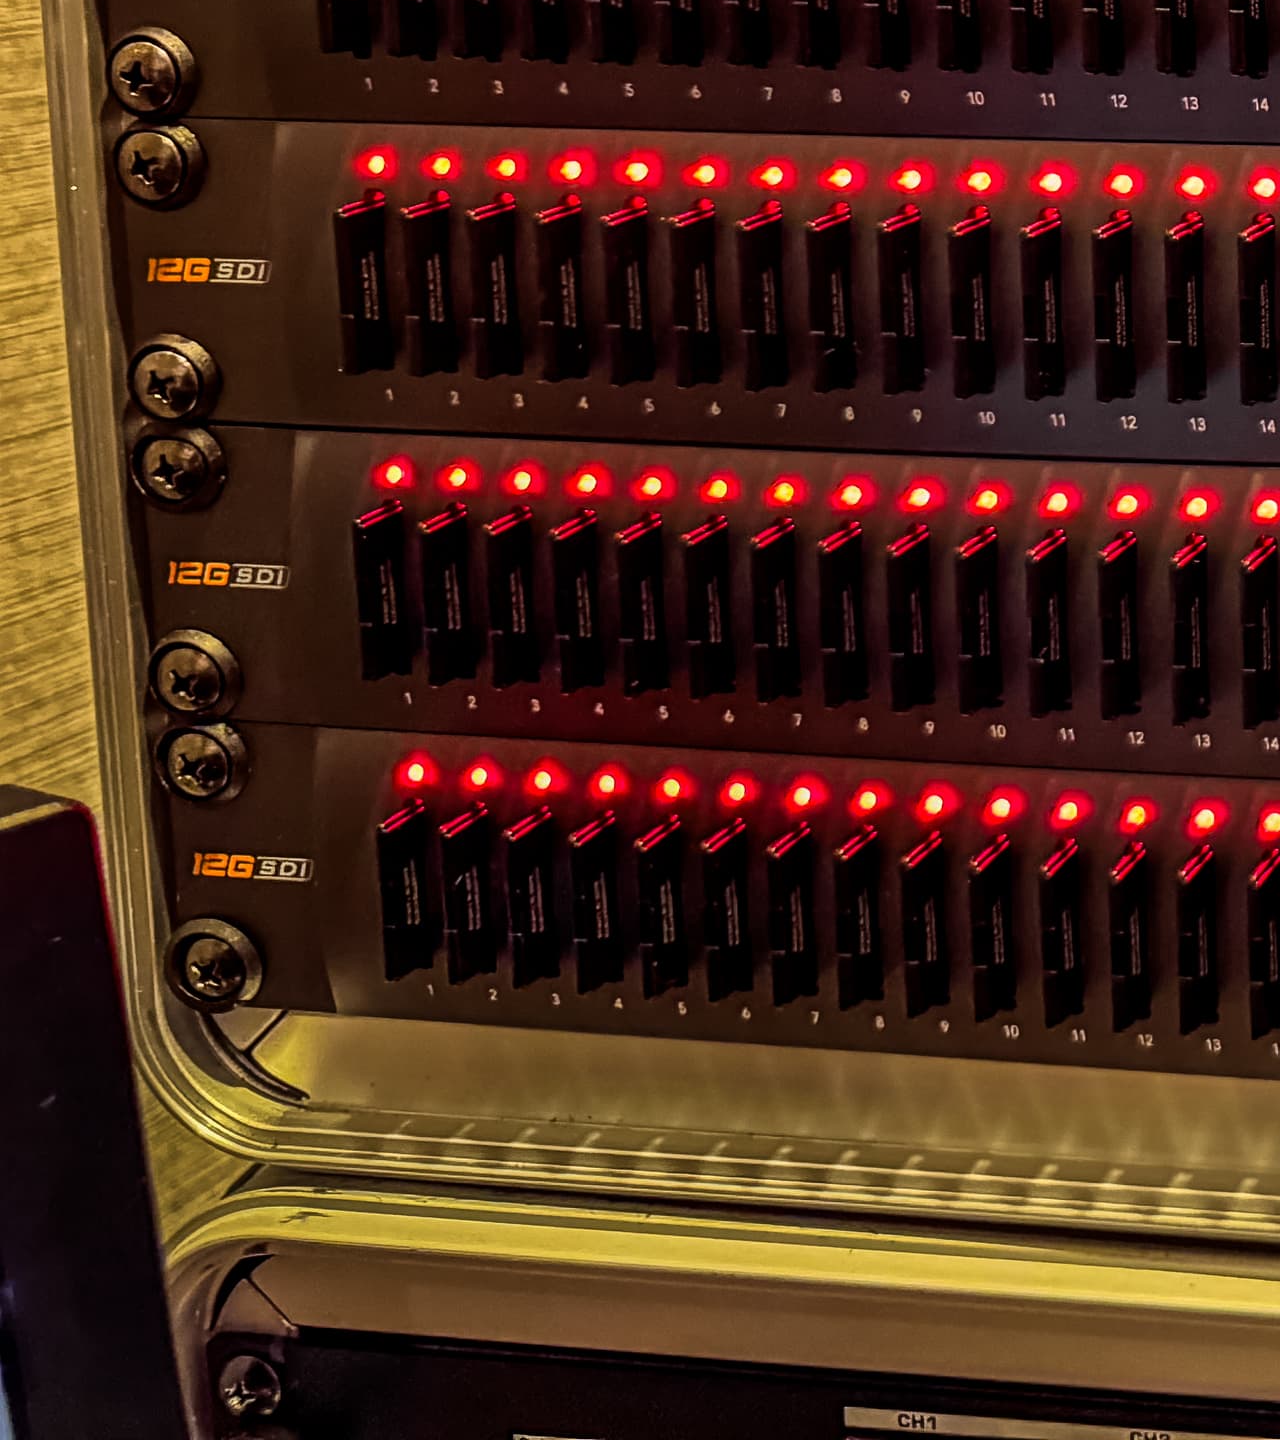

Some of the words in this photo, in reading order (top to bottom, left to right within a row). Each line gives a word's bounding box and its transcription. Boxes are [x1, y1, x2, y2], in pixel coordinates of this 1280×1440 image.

[966, 91, 985, 106] 10
[1039, 92, 1056, 107] 11
[1110, 94, 1128, 109] 12
[1181, 96, 1199, 111] 13
[1252, 97, 1269, 112] 14
[149, 258, 210, 281] 12G
[214, 263, 268, 281] SDI
[169, 562, 230, 585] 12G
[236, 567, 283, 585] SDI
[193, 853, 254, 878] 12G
[259, 860, 306, 877] SDI
[897, 1413, 937, 1430] CH1
